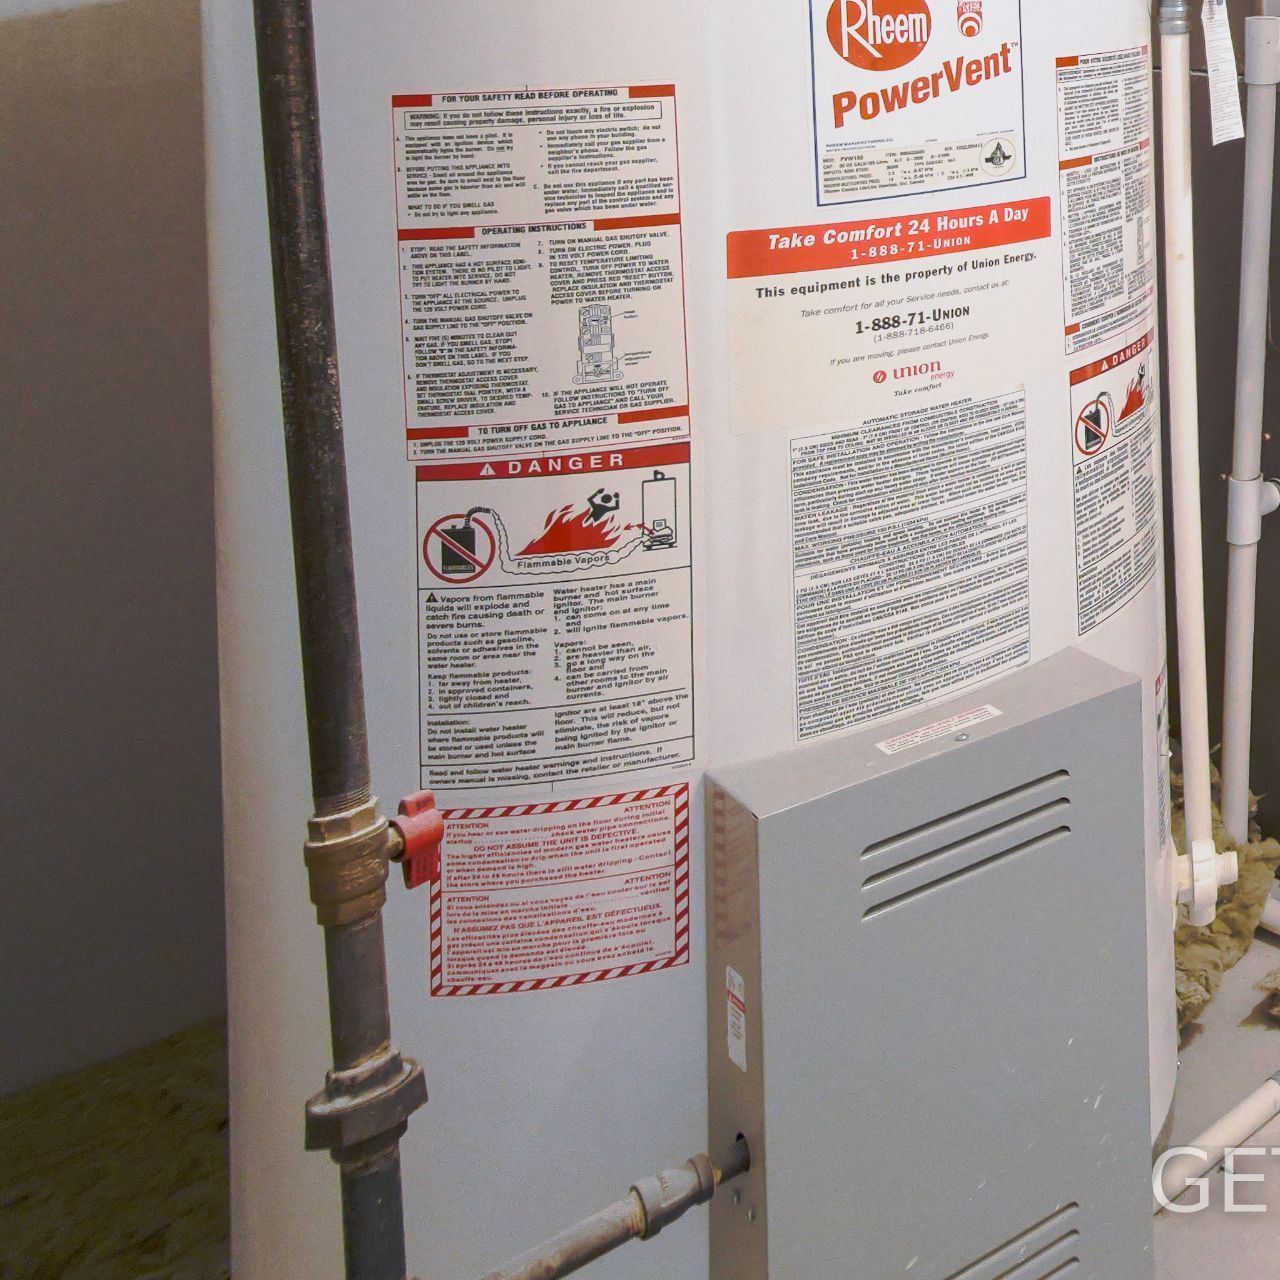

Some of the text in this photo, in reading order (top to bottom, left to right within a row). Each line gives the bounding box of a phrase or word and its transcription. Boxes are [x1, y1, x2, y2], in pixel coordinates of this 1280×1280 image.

[442, 88, 618, 103] FOR YOUR SAFETY READ BEFORE OPERATING
[481, 222, 586, 235] OPERATING INSTRUCTIONS
[768, 208, 1028, 250] Take Comfort 24 Hours A Day
[756, 252, 1036, 298] This equipment is the property of Union Energy.
[801, 308, 821, 318] Take
[824, 304, 858, 314] comfort
[861, 302, 872, 310] for
[887, 297, 904, 307] your
[906, 293, 935, 303] Service
[964, 283, 989, 294] contact
[873, 322, 954, 343] (1-888-718-6466)
[837, 357, 850, 367] you
[867, 350, 895, 361] moving,
[897, 345, 921, 356] please
[923, 339, 947, 350] contact
[949, 336, 967, 346] Union
[1111, 340, 1146, 366] DANGER
[893, 360, 941, 380] union
[930, 370, 954, 381] energy
[894, 382, 942, 397] Take comfort
[863, 398, 972, 425] AUTOMATIC STORAGE WATER HEATER
[490, 426, 511, 434] TURN
[531, 423, 547, 431] GAS
[562, 418, 608, 428] APPLIANCE
[508, 453, 624, 474] DANGER
[517, 554, 610, 569] Flammable Vapors
[496, 591, 544, 600] flammable
[474, 602, 510, 611] explode
[468, 611, 504, 620] causing
[624, 800, 671, 813] ATTENTION
[624, 872, 671, 884] ATTENTION
